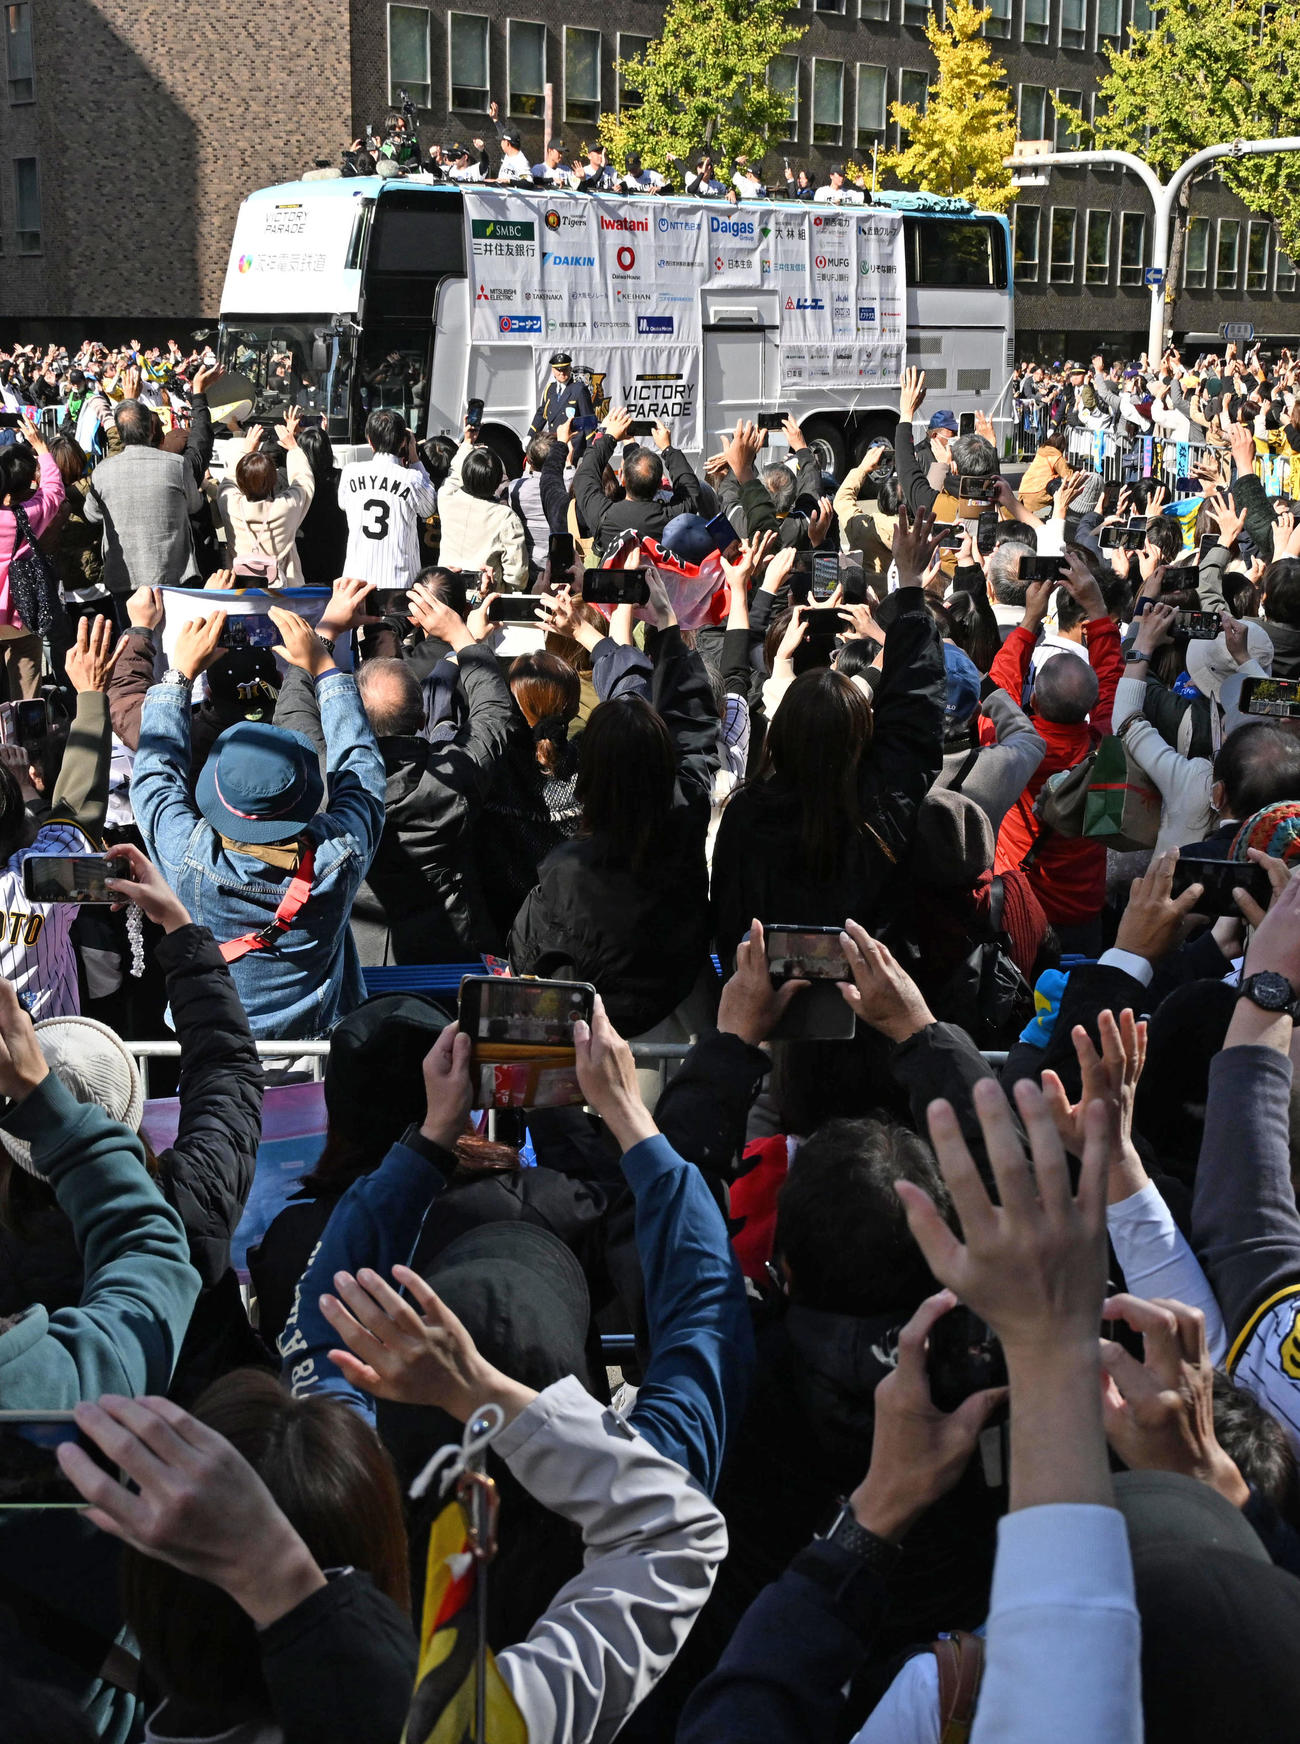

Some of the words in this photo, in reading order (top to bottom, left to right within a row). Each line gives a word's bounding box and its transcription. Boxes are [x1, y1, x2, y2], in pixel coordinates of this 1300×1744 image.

[265, 211, 309, 222] VICTORY
[562, 216, 587, 228] Tigers
[266, 223, 306, 234] PARADE
[600, 215, 649, 232] Iwatani
[710, 215, 755, 237] Daigas
[496, 225, 522, 237] SMBC
[775, 228, 807, 241] 大林組
[472, 242, 536, 257] 三井住友銀行
[553, 255, 596, 267] DAIKIN
[728, 259, 753, 269] 日本生命
[827, 258, 850, 267] MUFG
[870, 264, 897, 274] りそな銀行
[533, 293, 563, 301] TAKENAKA
[511, 320, 541, 329] コーナン
[622, 384, 694, 401] VICTORY
[626, 402, 692, 418] PARADE
[349, 475, 411, 501] OHYAMA
[362, 499, 390, 540] 3
